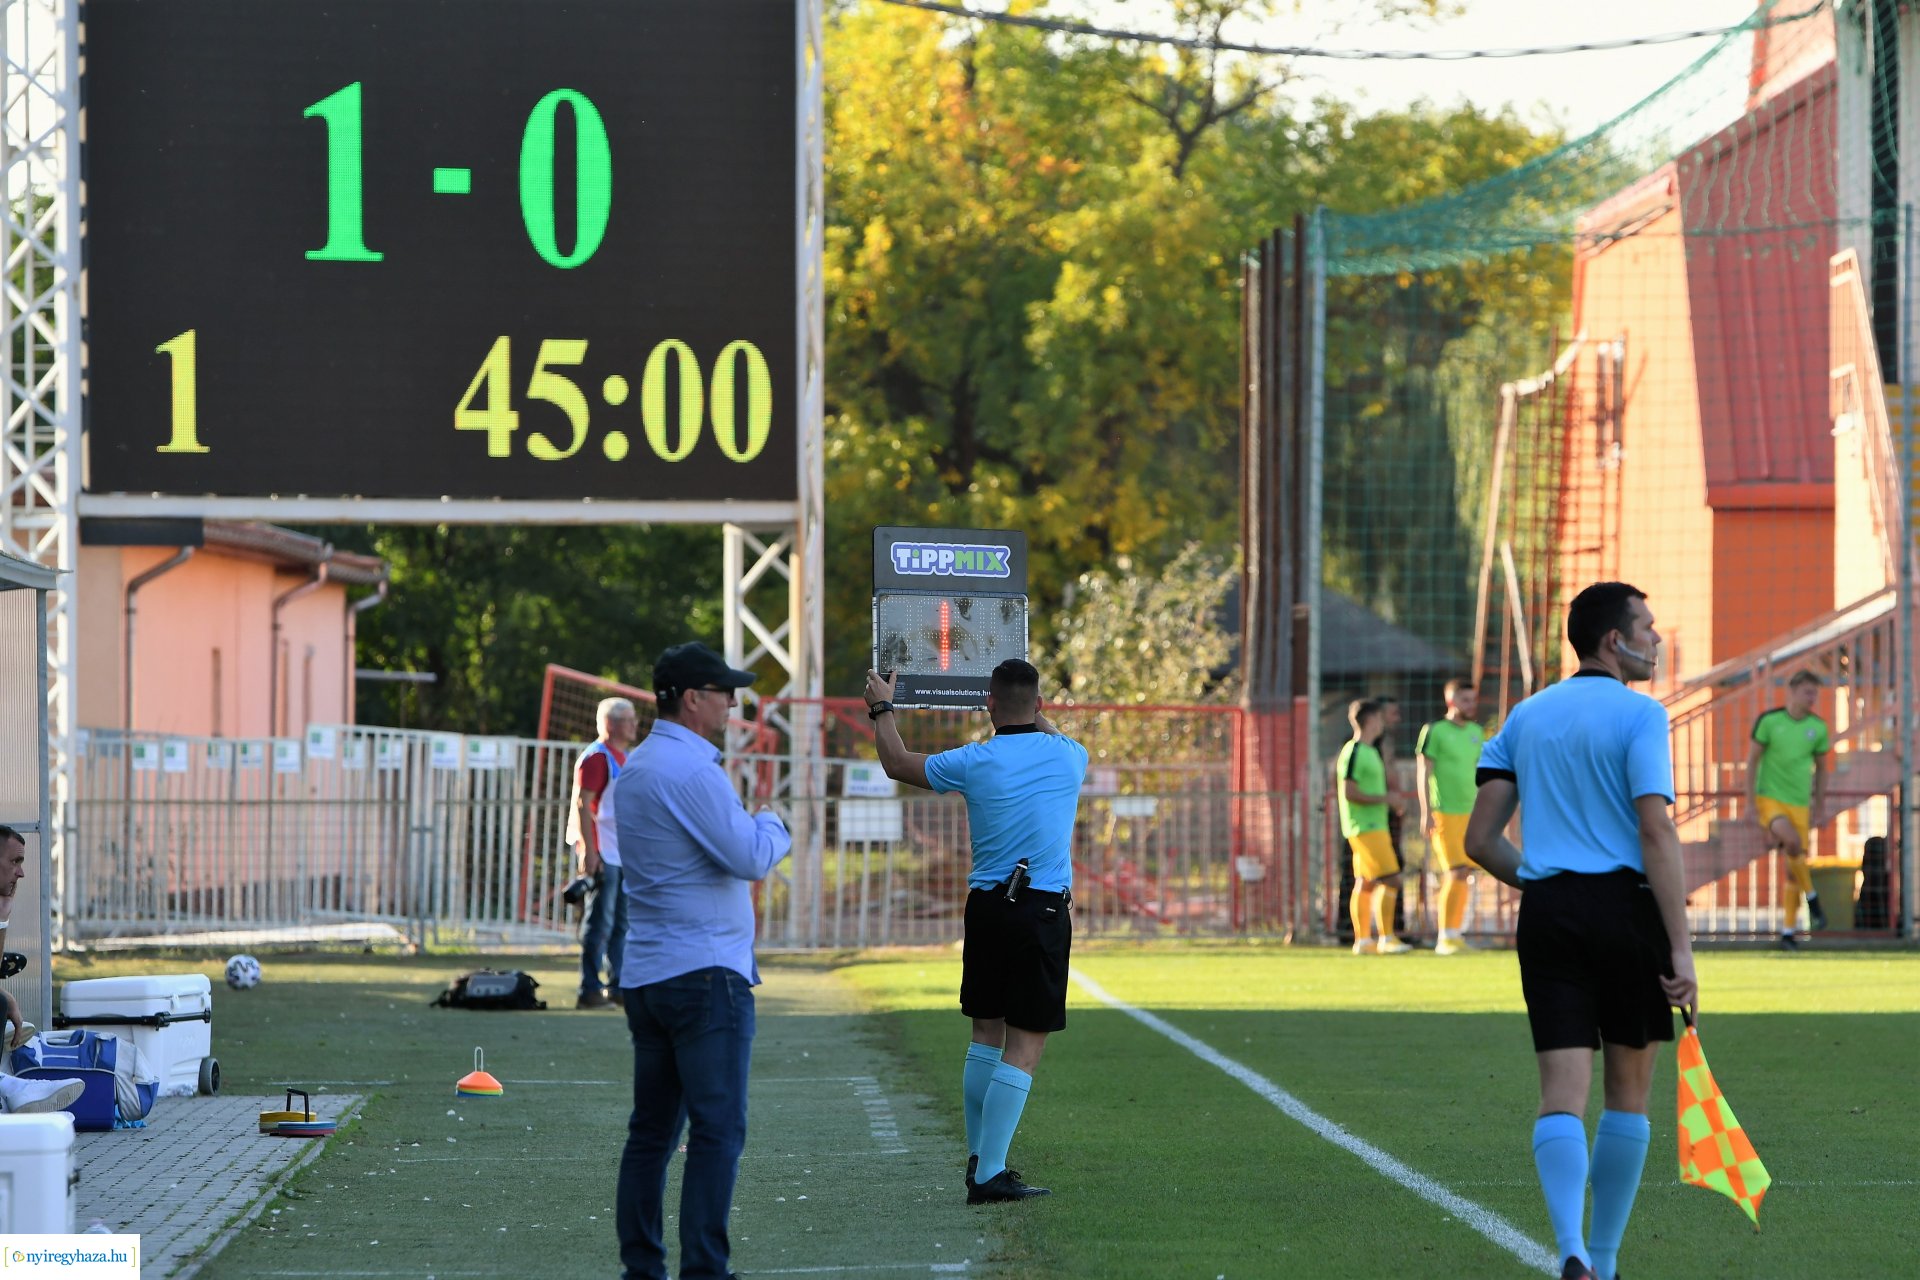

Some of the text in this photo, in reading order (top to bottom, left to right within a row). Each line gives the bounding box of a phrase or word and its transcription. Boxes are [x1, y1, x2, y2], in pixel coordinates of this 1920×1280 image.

[303, 81, 612, 270] 1 - 0
[155, 328, 211, 453] 1
[454, 335, 773, 463] 45:00
